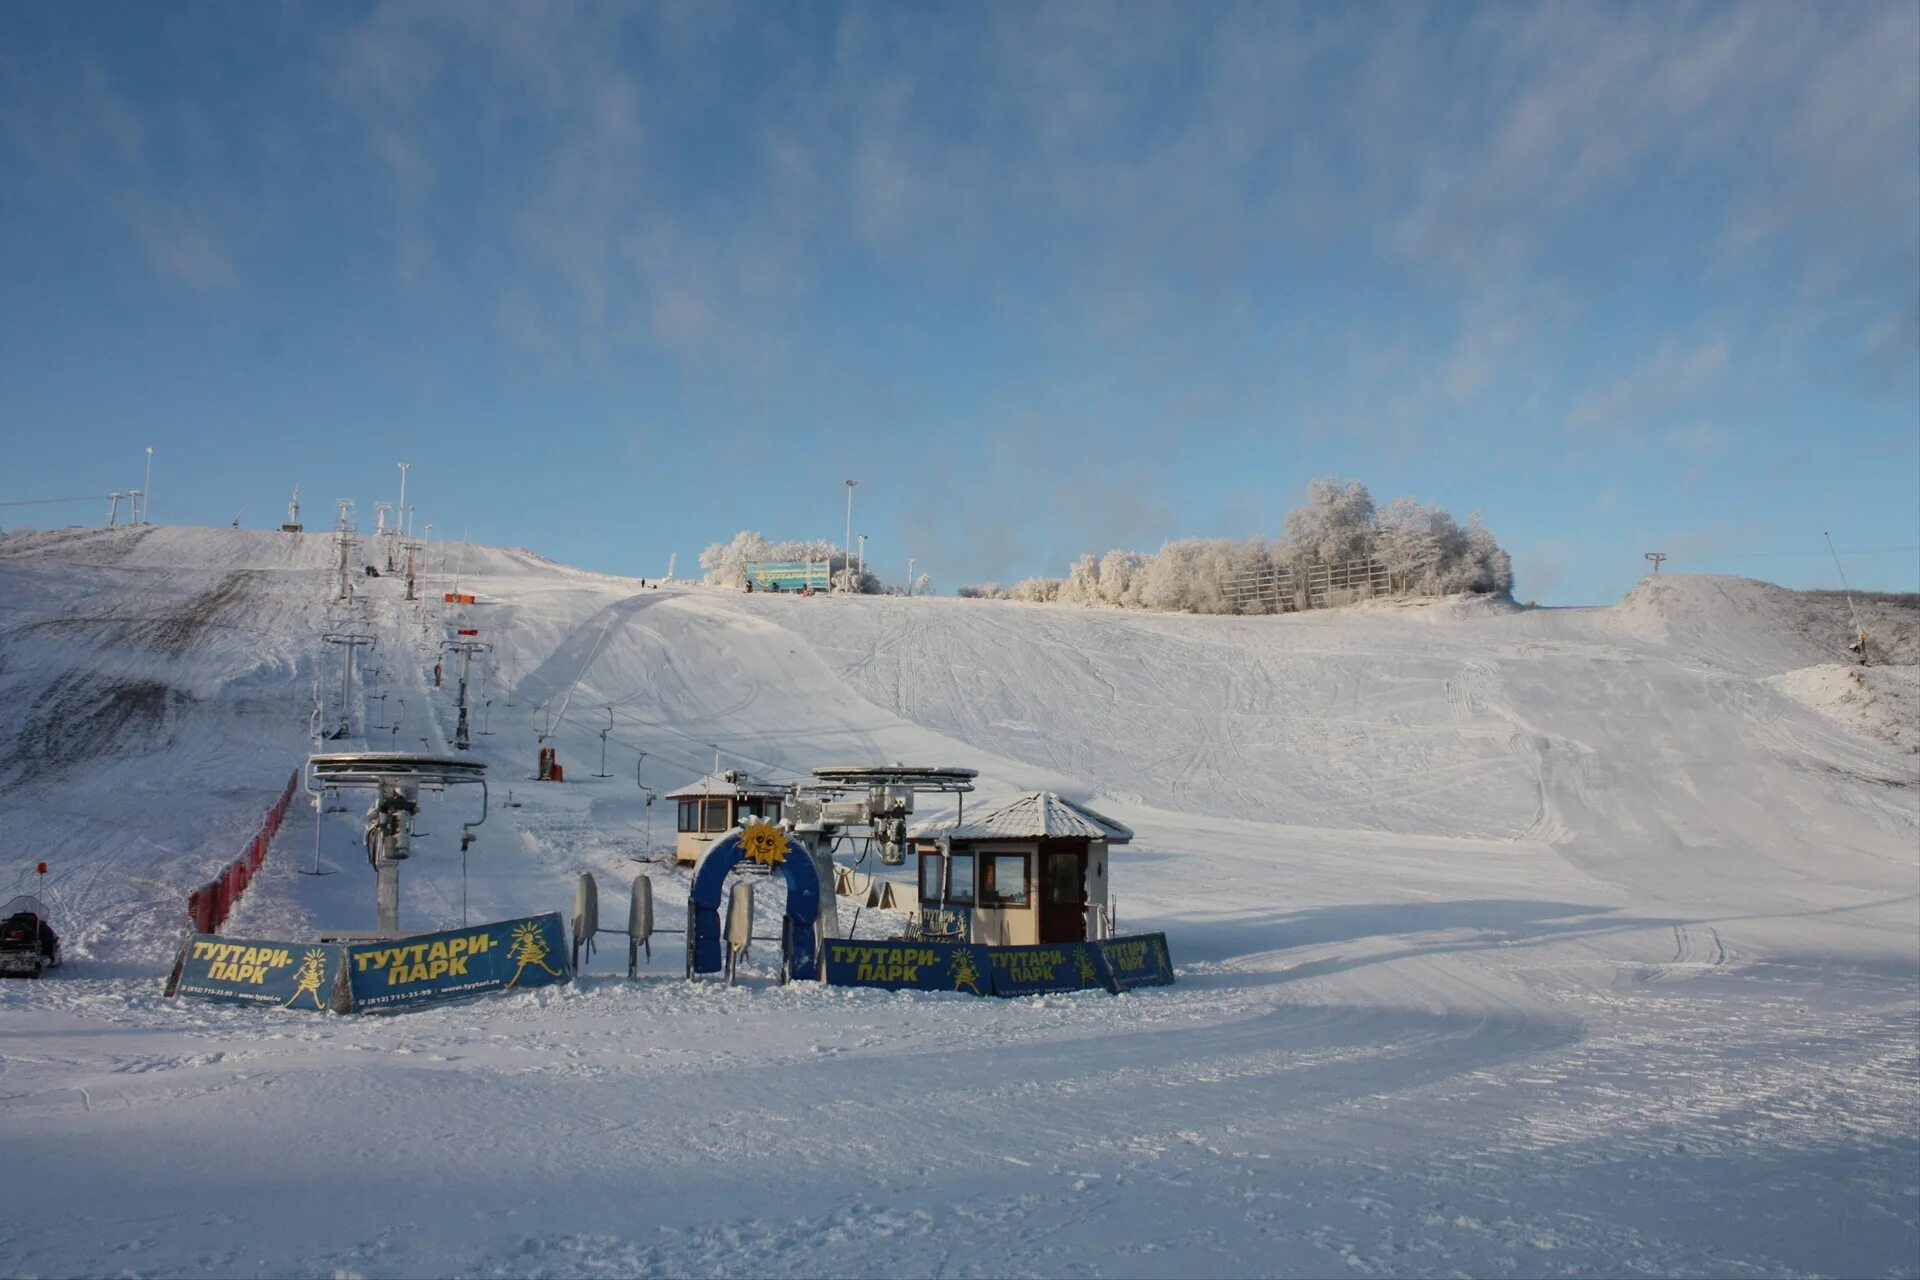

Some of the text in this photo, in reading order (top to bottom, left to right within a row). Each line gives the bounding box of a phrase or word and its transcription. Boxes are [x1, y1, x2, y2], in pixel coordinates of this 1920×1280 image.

[194, 941, 294, 969] ТУУТАРИ-
[354, 933, 498, 972] ТУУТАРИ-
[831, 945, 941, 966] ТУУТАРИ-
[989, 949, 1067, 969] ТУУТАРИ-
[207, 961, 270, 985] ПАРК
[387, 955, 469, 986] ПАРК
[856, 963, 918, 982] ПАРК
[1010, 965, 1056, 983] ПАРК
[1119, 956, 1146, 972] ПАРК
[367, 995, 388, 1006] (812)
[440, 978, 500, 993] www.tyytari.ru
